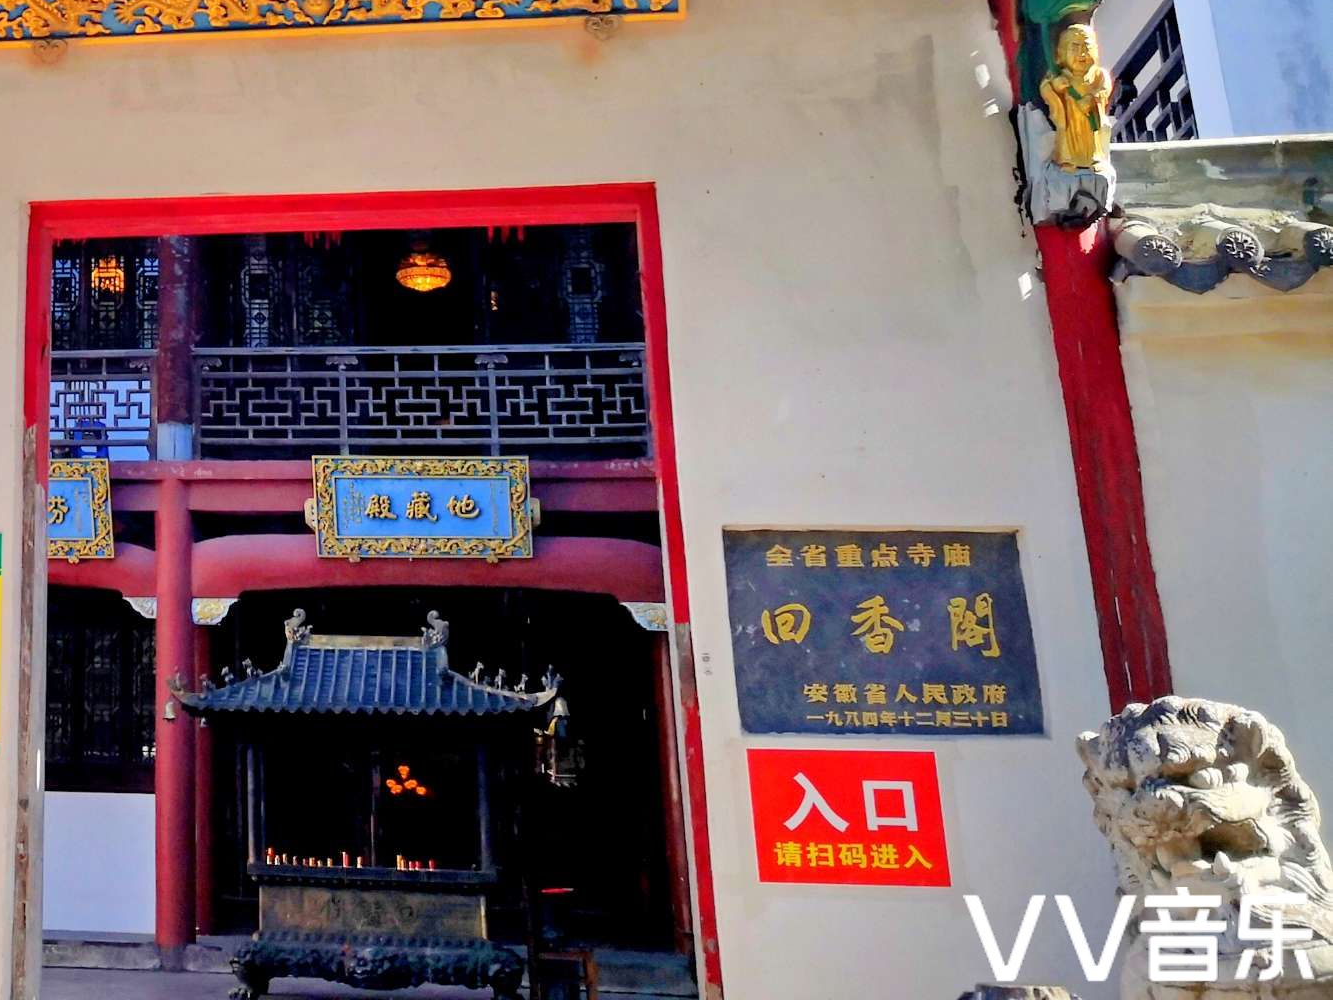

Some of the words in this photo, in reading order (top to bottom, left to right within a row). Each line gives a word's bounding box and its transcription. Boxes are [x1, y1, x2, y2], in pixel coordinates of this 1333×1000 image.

[765, 543, 972, 568] 全省重点寺庙
[803, 683, 1008, 705] 安徽省人民政府
[806, 711, 1008, 728] 一九八四年十二月三十日
[783, 772, 919, 833] 入口
[774, 842, 933, 870] 请扫码进入
